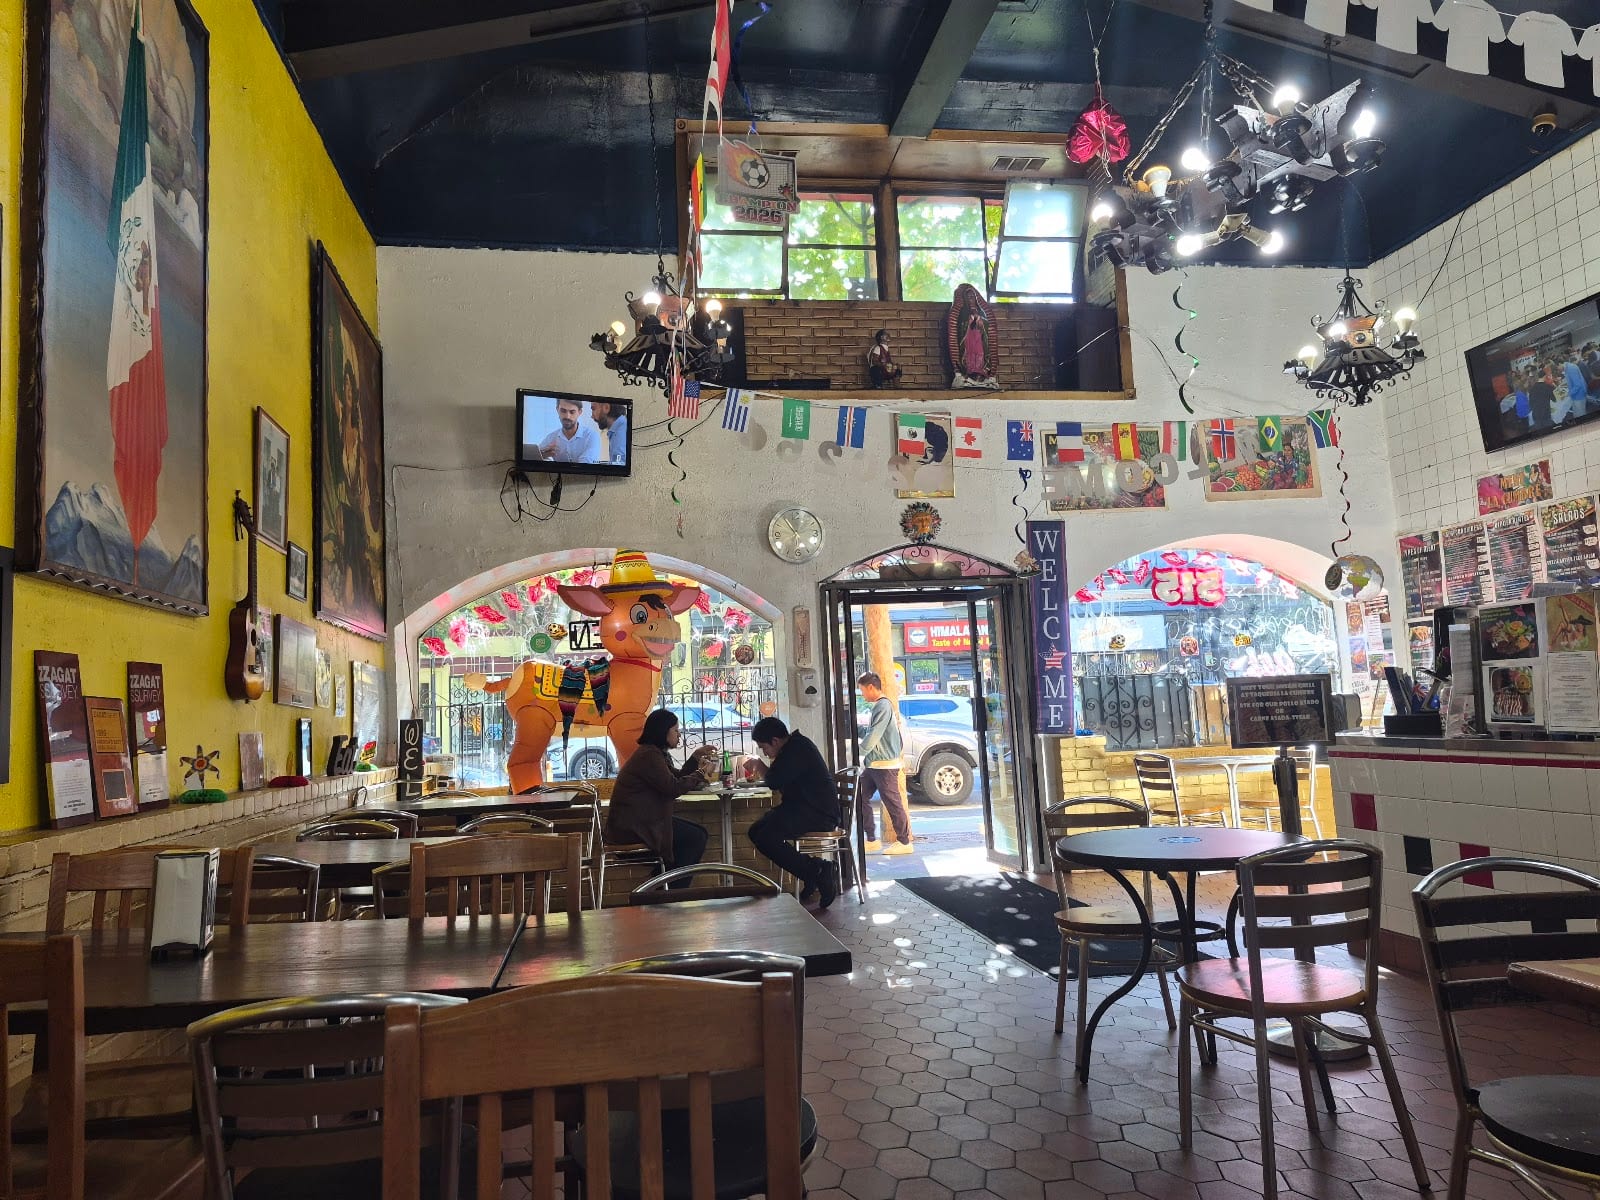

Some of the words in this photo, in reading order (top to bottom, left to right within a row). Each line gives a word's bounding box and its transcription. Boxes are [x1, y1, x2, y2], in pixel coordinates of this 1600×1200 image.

[1049, 435, 1098, 445] MCO
[1553, 508, 1585, 525] SALADS
[930, 624, 989, 637] HIMALAAN
[1033, 530, 1068, 729] WELCME
[931, 639, 951, 647] Taste
[953, 637, 961, 646] of
